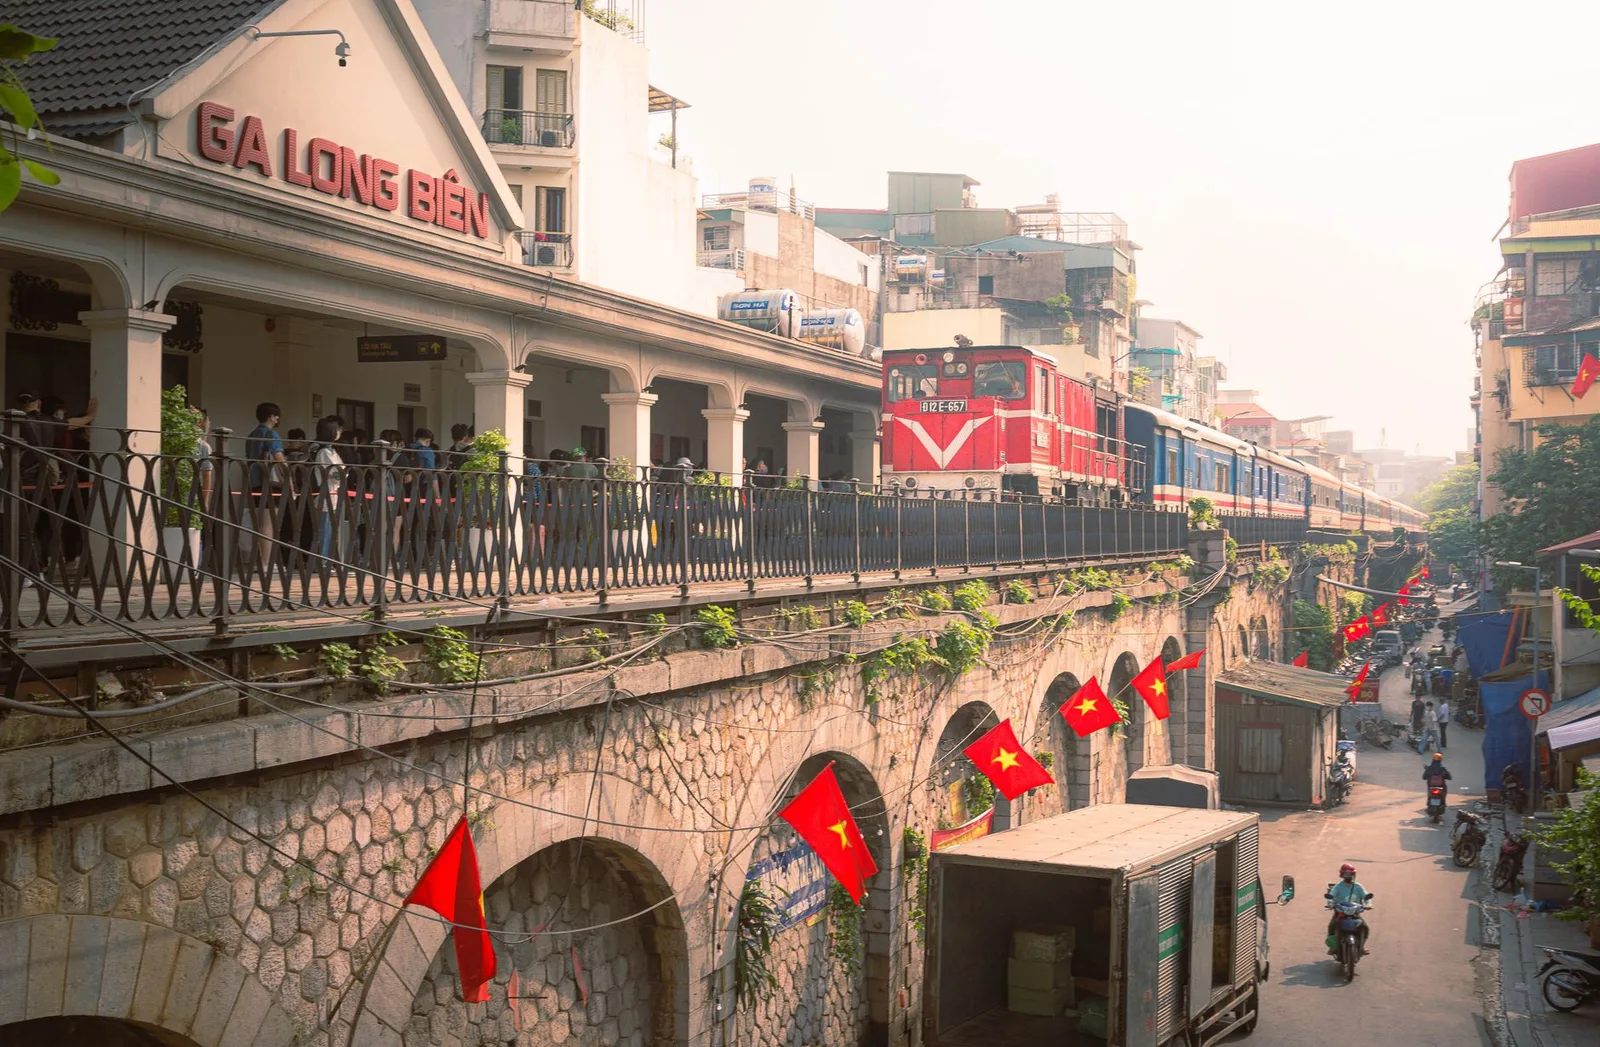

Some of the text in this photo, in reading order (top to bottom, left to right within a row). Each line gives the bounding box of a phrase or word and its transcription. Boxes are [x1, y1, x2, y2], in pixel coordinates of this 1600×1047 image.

[197, 101, 488, 238] GA LONG BIÊN
